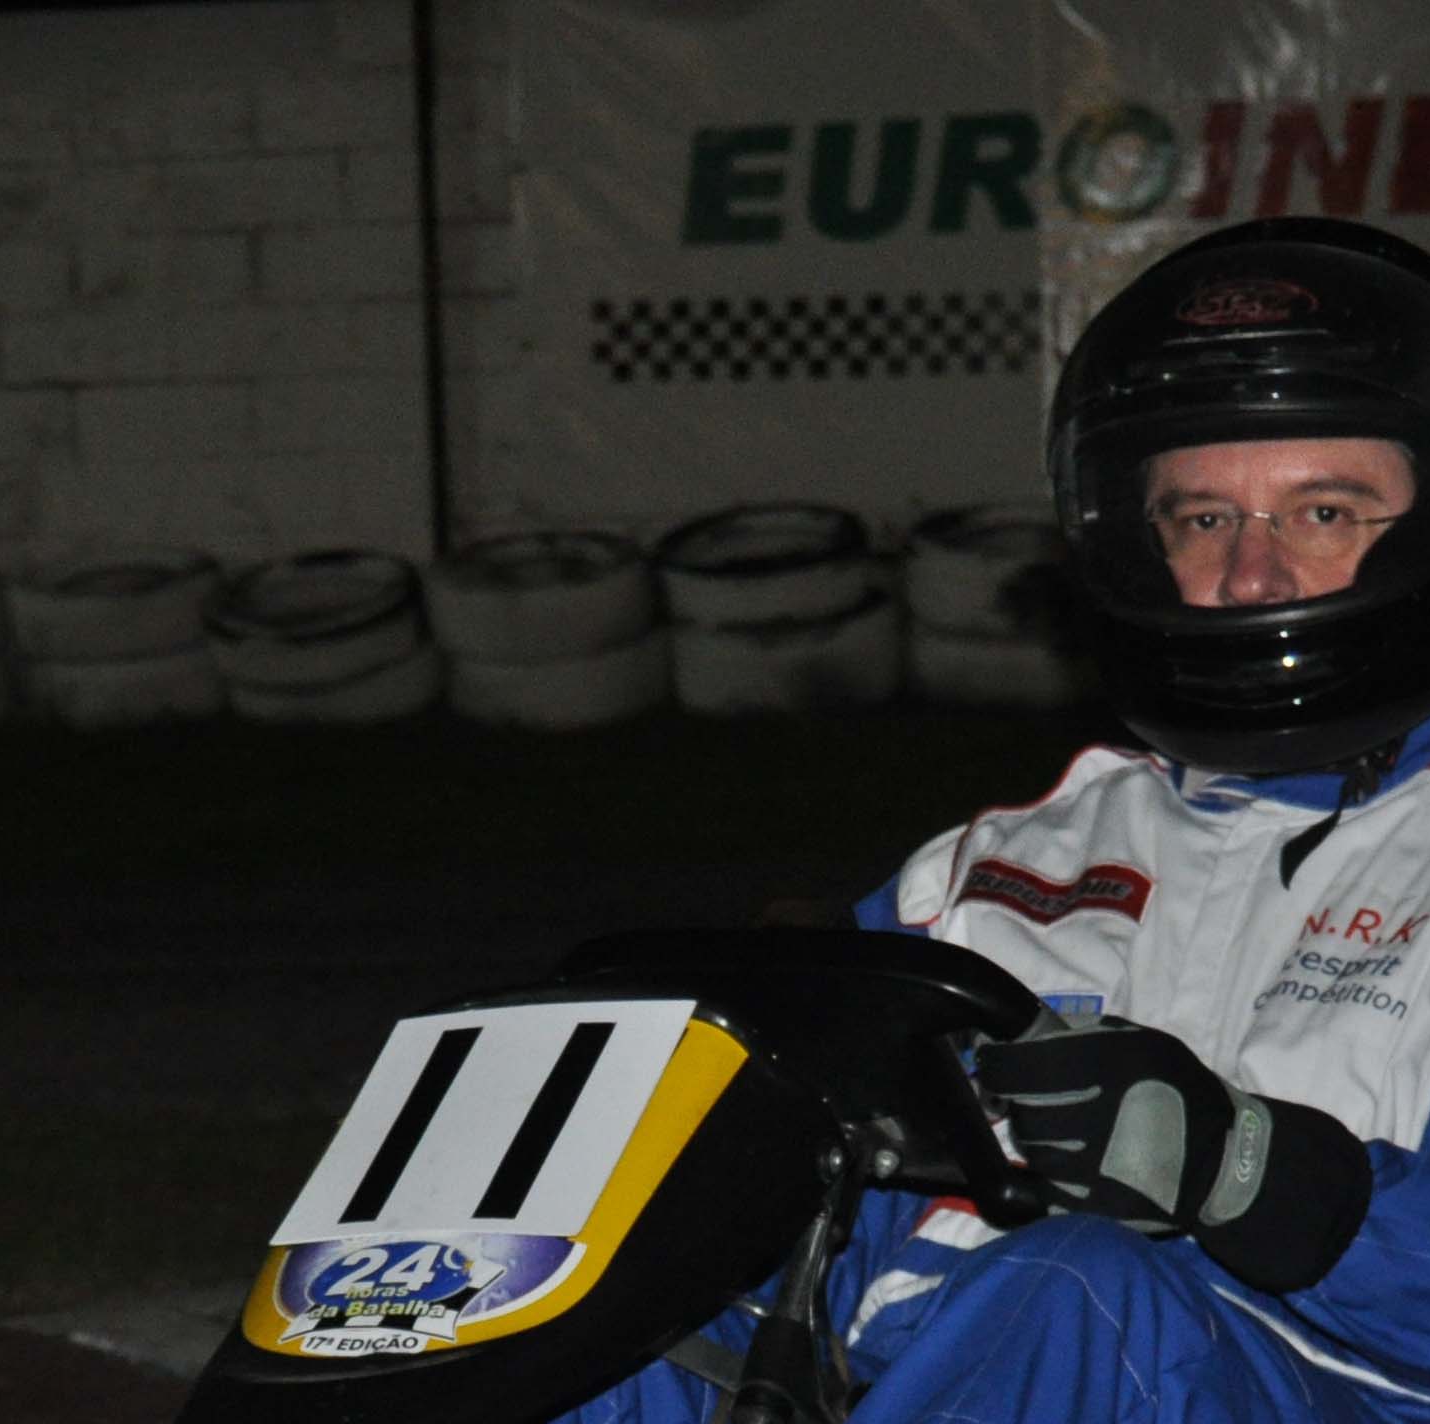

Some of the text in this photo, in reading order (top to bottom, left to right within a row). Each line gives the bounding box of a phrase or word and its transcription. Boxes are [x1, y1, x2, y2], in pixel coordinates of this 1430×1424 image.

[338, 1022, 617, 1222] 11
[325, 1245, 443, 1297] 24
[345, 1284, 410, 1300] horas
[307, 1299, 447, 1320] da Batalha
[336, 1333, 419, 1352] EDIÇÃO
